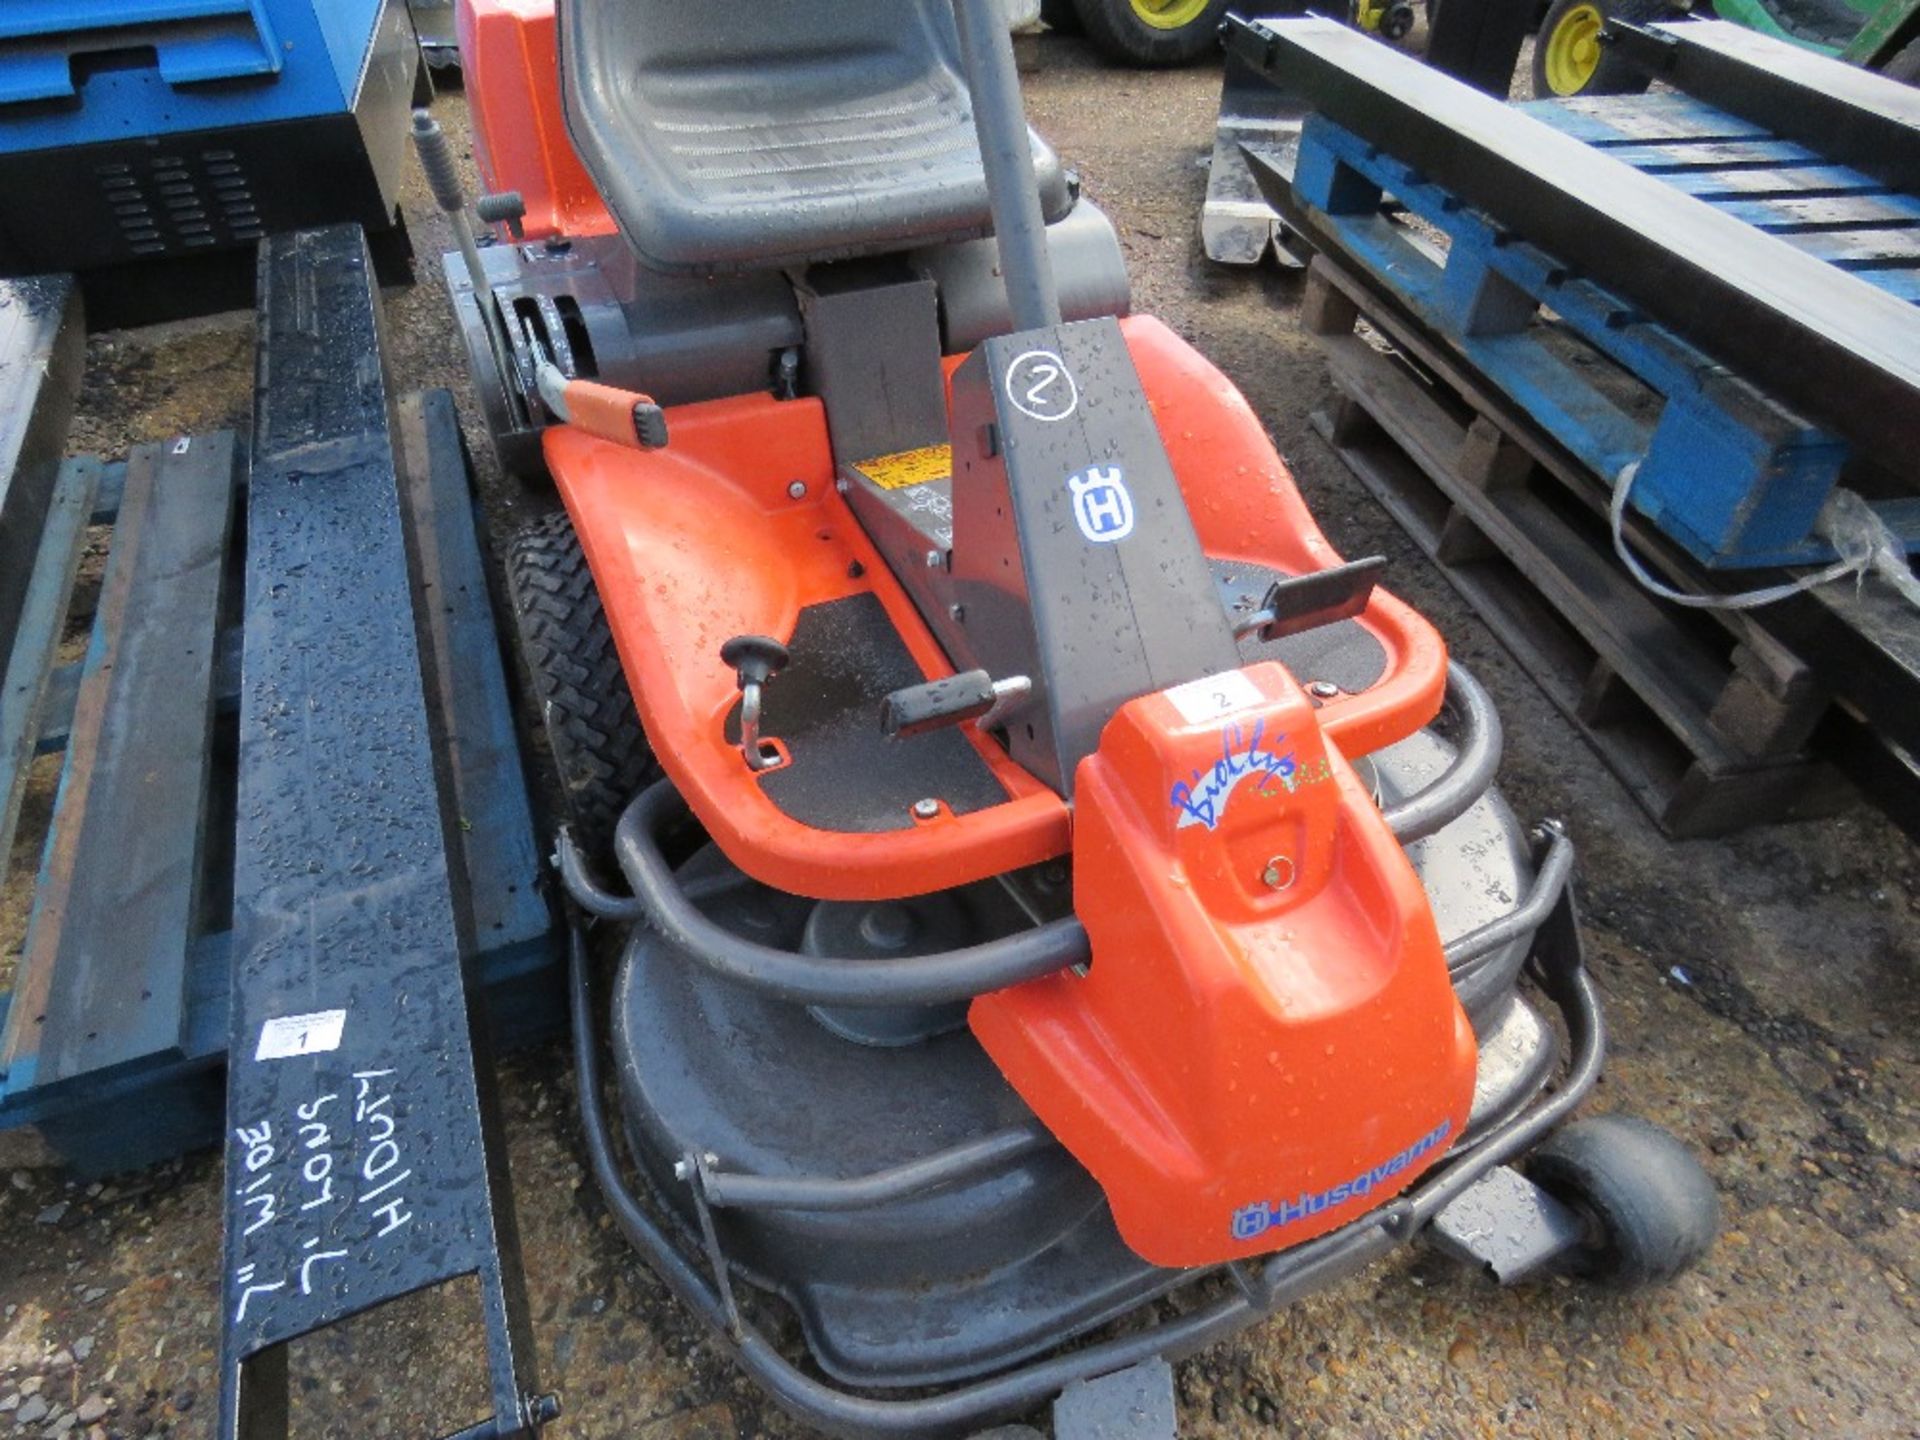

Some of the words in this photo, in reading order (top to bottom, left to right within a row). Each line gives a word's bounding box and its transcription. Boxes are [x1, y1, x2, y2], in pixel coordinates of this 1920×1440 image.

[1026, 364, 1059, 404] 2
[1212, 692, 1232, 708] 2
[298, 1031, 308, 1049] 1
